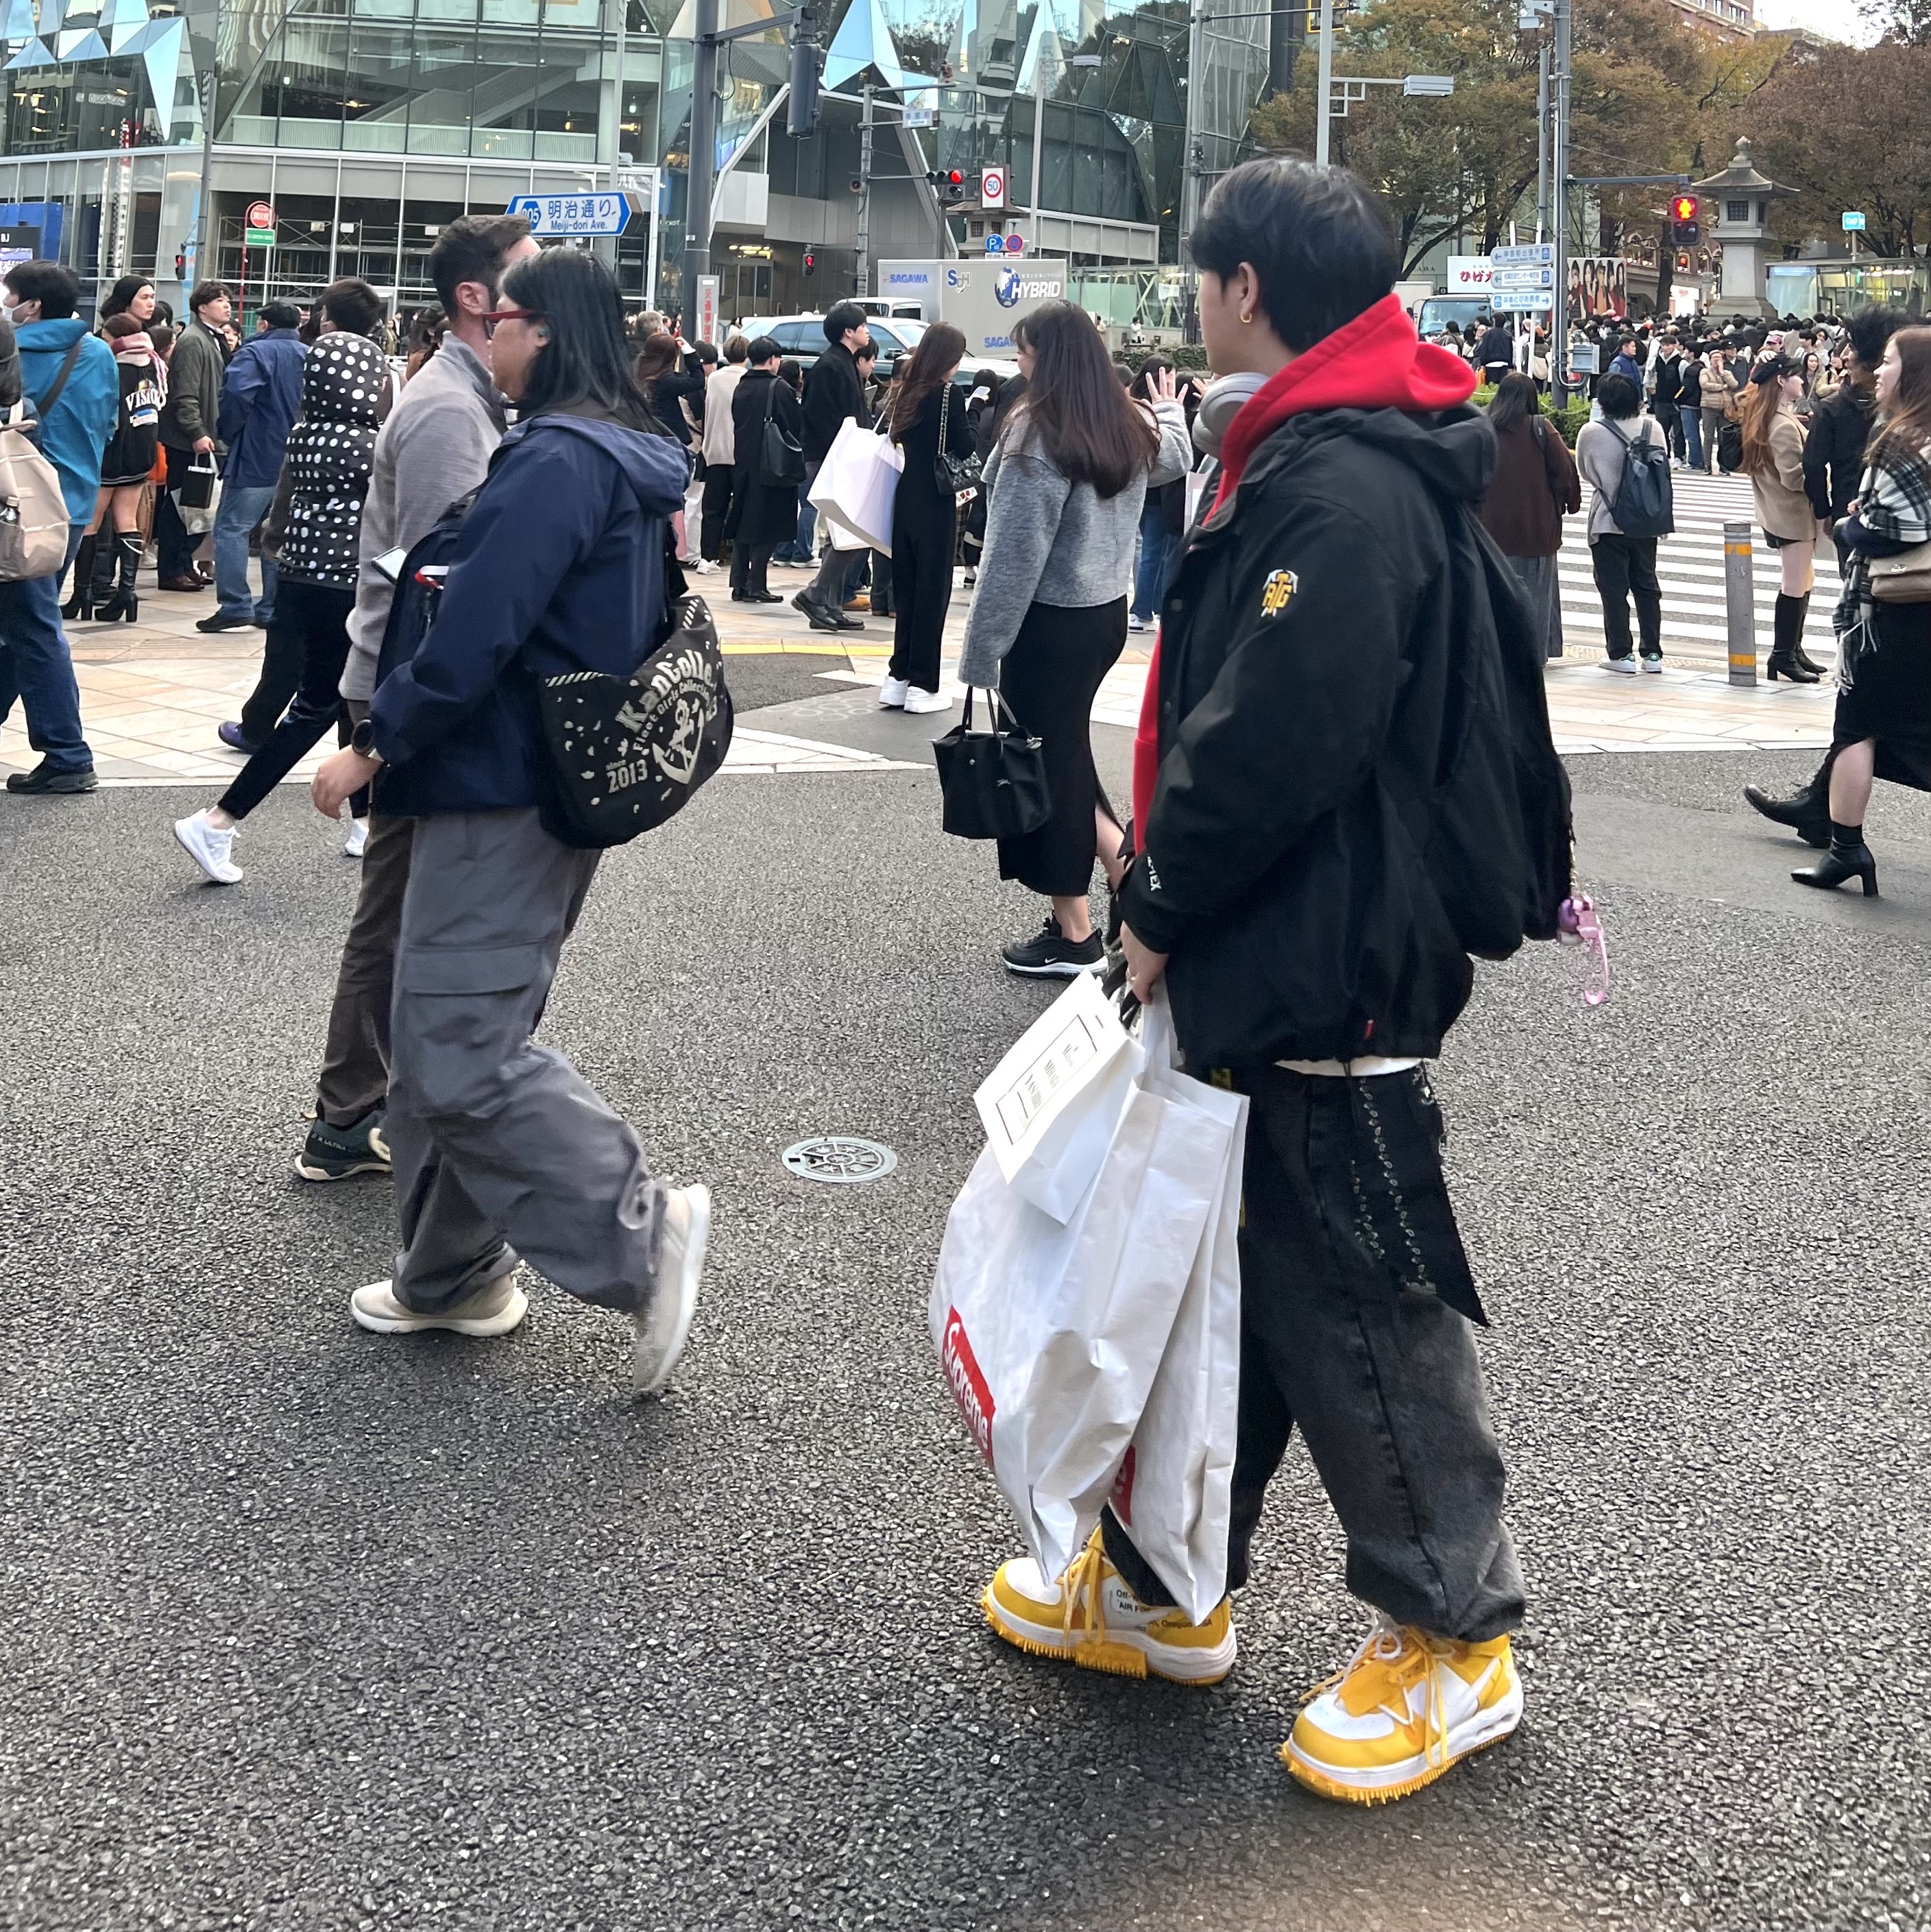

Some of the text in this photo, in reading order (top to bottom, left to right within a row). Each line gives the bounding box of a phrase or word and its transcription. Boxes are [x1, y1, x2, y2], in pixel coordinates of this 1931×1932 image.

[988, 181, 998, 191] 50
[548, 200, 611, 219] 明治通り
[551, 219, 607, 232] Meiji-dori Ave.
[890, 274, 928, 283] SAGAWA
[1011, 280, 1061, 299] HYBRID
[984, 336, 1017, 348] SAGA
[125, 388, 163, 411] VISIO
[607, 759, 648, 793] 2013
